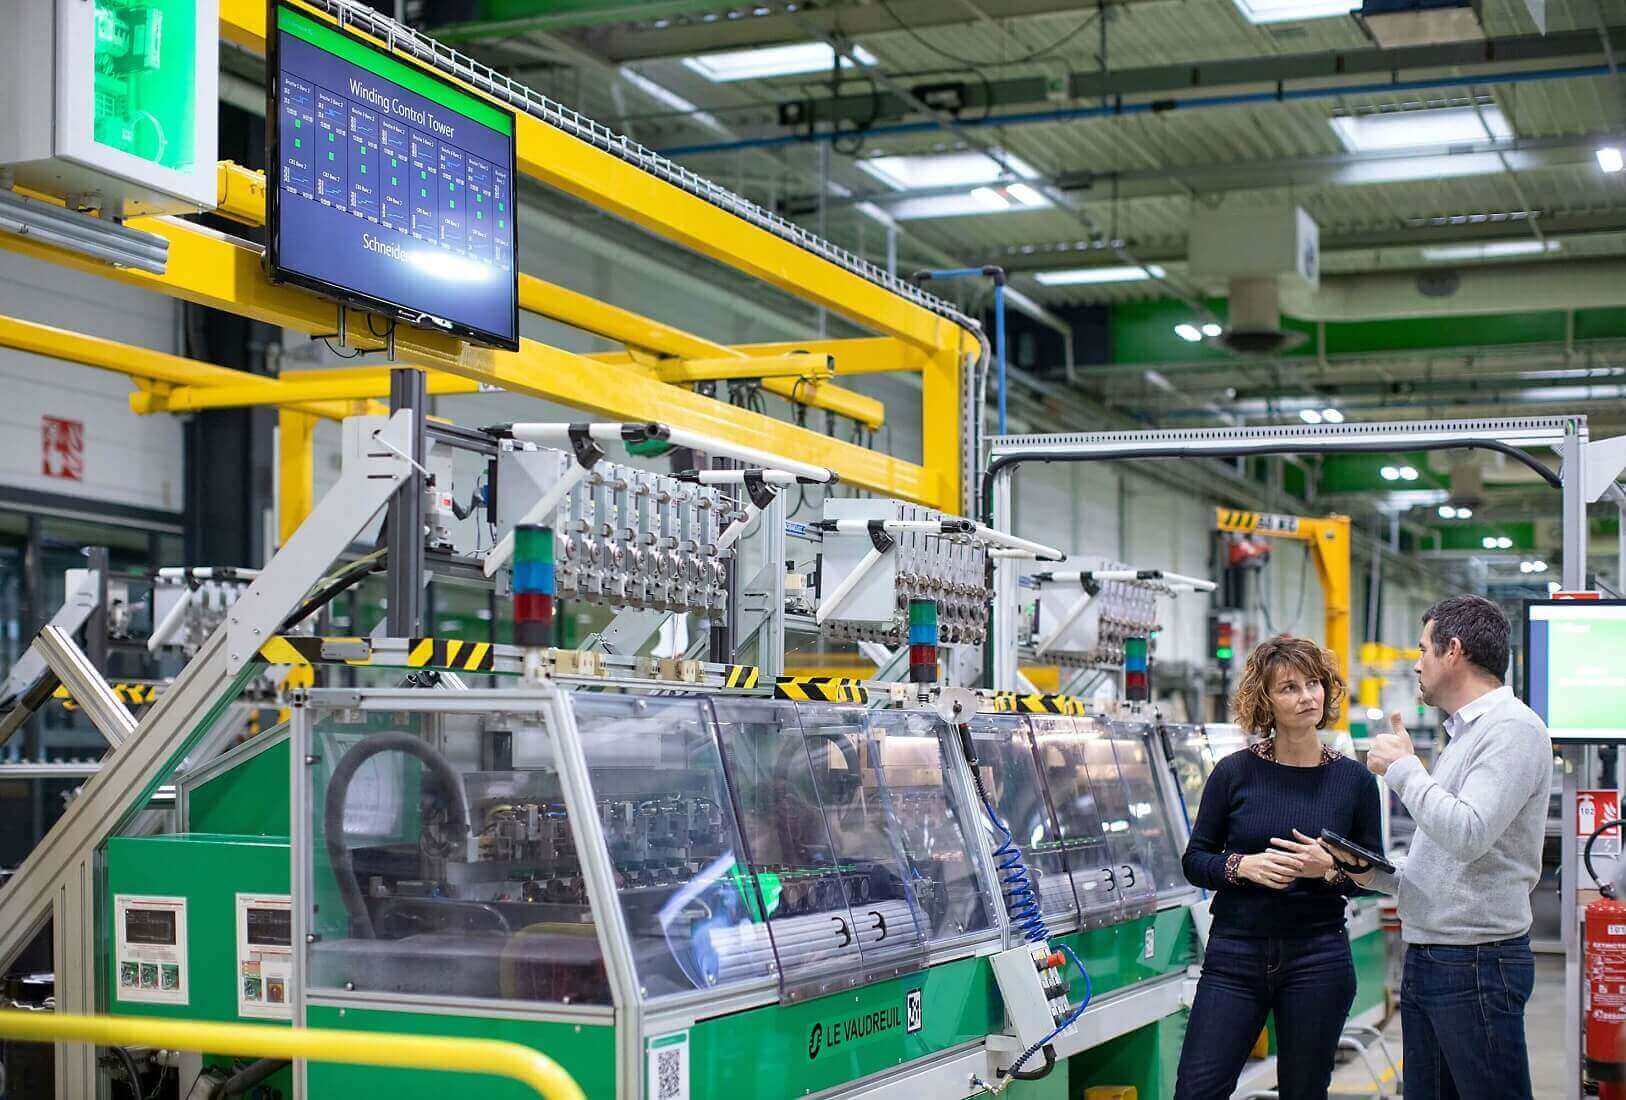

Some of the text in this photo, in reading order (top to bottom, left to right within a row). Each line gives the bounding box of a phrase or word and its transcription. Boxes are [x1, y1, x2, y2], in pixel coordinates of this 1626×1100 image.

[350, 78, 390, 113] Winding
[392, 98, 425, 126] Control
[427, 114, 455, 138] Tower
[826, 1006, 901, 1047] LE VAUDREUIL
